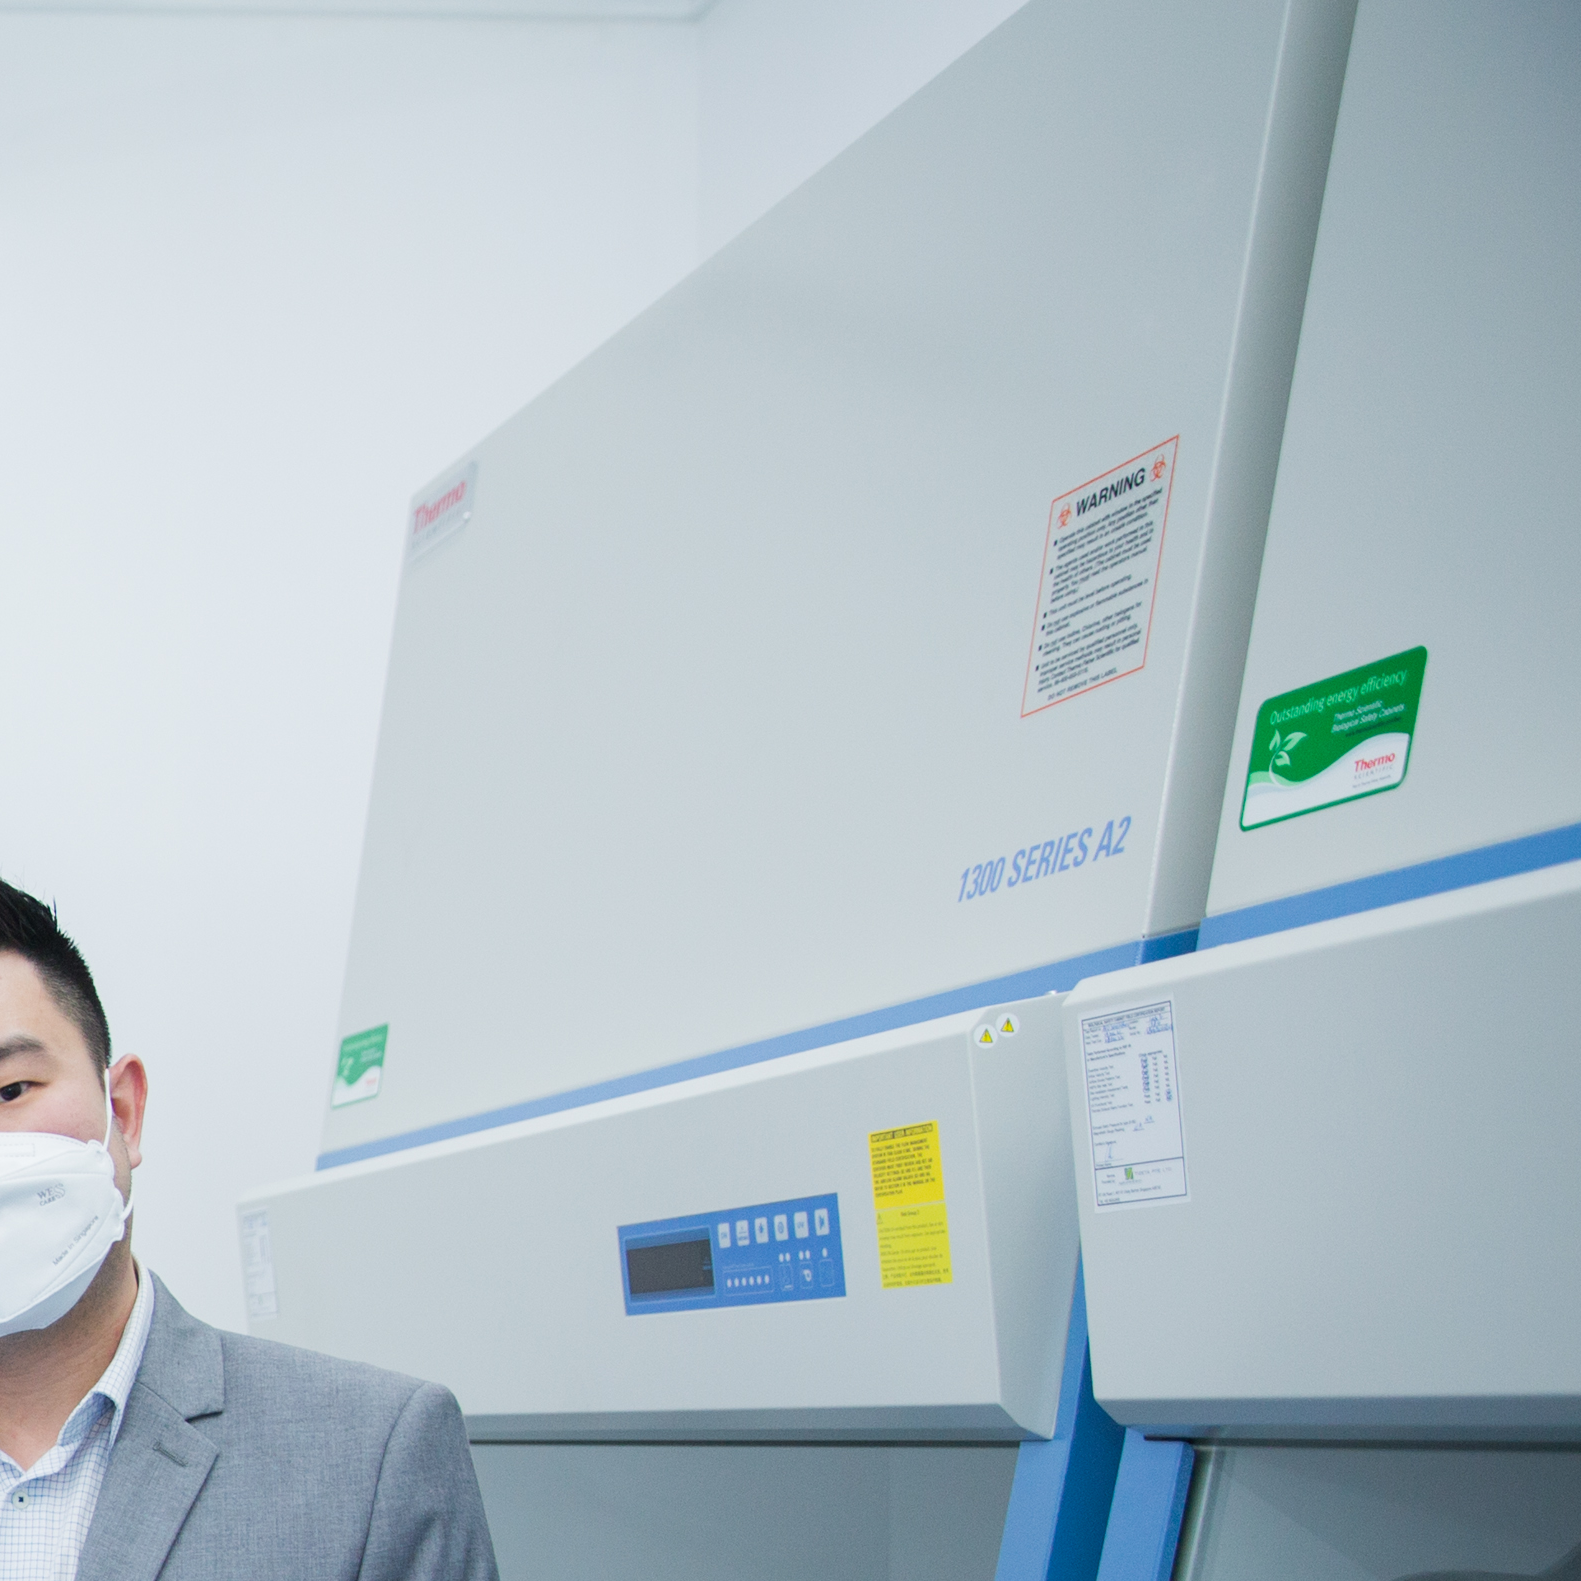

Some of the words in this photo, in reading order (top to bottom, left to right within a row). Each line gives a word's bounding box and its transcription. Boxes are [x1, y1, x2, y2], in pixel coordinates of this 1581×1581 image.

[1077, 467, 1146, 517] WARNING
[1269, 696, 1326, 726] Outstanding
[1326, 685, 1360, 707] energy
[1360, 669, 1408, 696] efficiency
[1354, 752, 1396, 773] Thermo
[957, 856, 1006, 903] 1300
[1007, 826, 1093, 888] SERIES
[1092, 815, 1132, 862] A2
